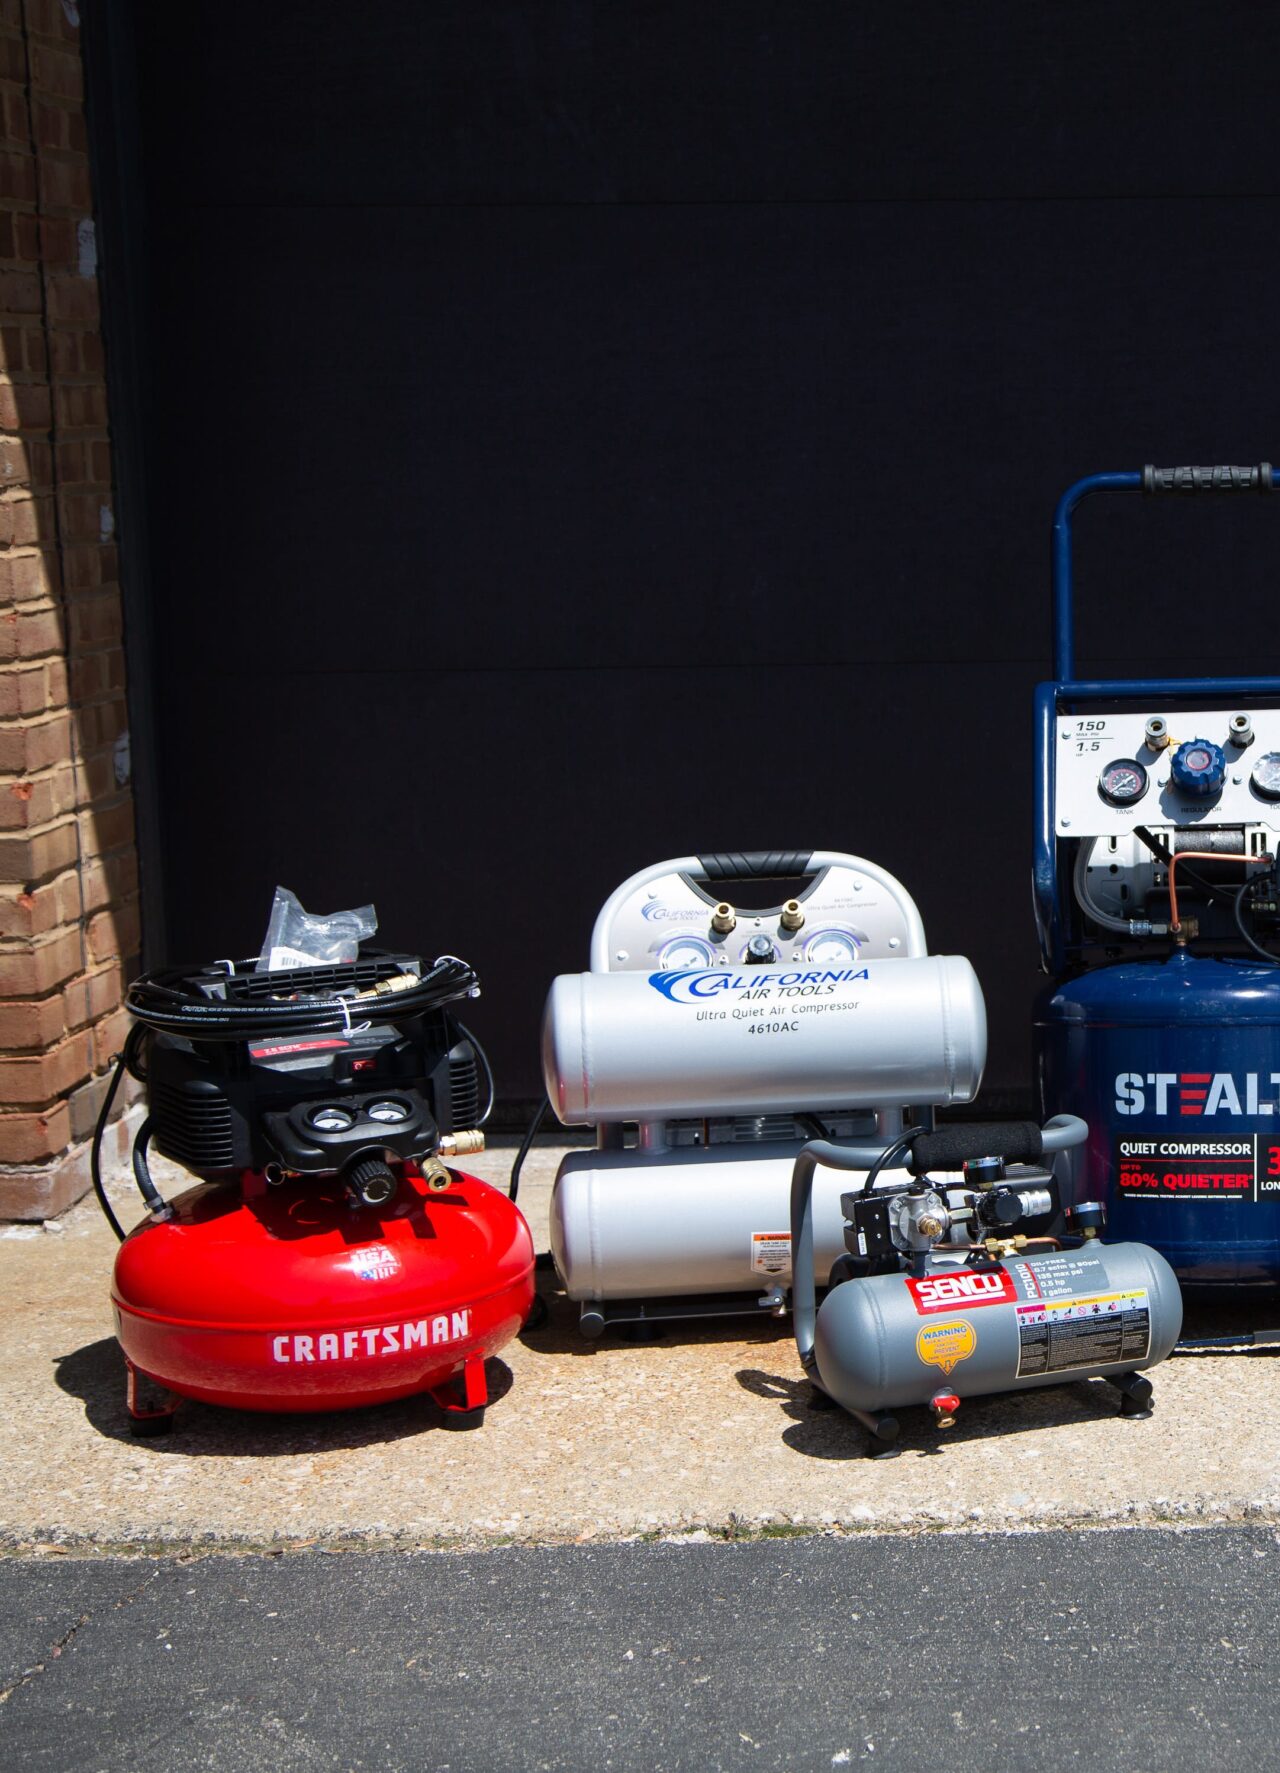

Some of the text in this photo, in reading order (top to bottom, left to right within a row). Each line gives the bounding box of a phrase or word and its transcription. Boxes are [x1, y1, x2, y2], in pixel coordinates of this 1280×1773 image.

[1076, 721, 1106, 731] 150
[1076, 741, 1101, 752] 1.5
[1181, 806, 1222, 814] REGULATOR
[653, 908, 709, 920] CALIFORNIA
[688, 968, 869, 997] CALIFORNIA
[738, 983, 837, 1001] AIR TOOLS
[696, 1000, 860, 1021] Ultra Quiet Air Compressor
[747, 1020, 799, 1035] 4610AC
[1120, 1142, 1252, 1157] QUIET COMPRESSOR
[1120, 1172, 1159, 1188] 80%
[351, 1250, 396, 1264] USA
[1030, 1258, 1066, 1267] OIL-FREE
[1047, 1263, 1068, 1271] scfm
[1077, 1259, 1100, 1267] 90psi
[1071, 1268, 1084, 1277] psi
[915, 1274, 1004, 1301] SENCO
[1014, 1263, 1038, 1299] PC1010
[1040, 1279, 1066, 1288] 0.5 hp
[1048, 1286, 1073, 1297] gallon
[273, 1308, 470, 1363] CRAFTSMAN
[922, 1325, 968, 1341] WARNING
